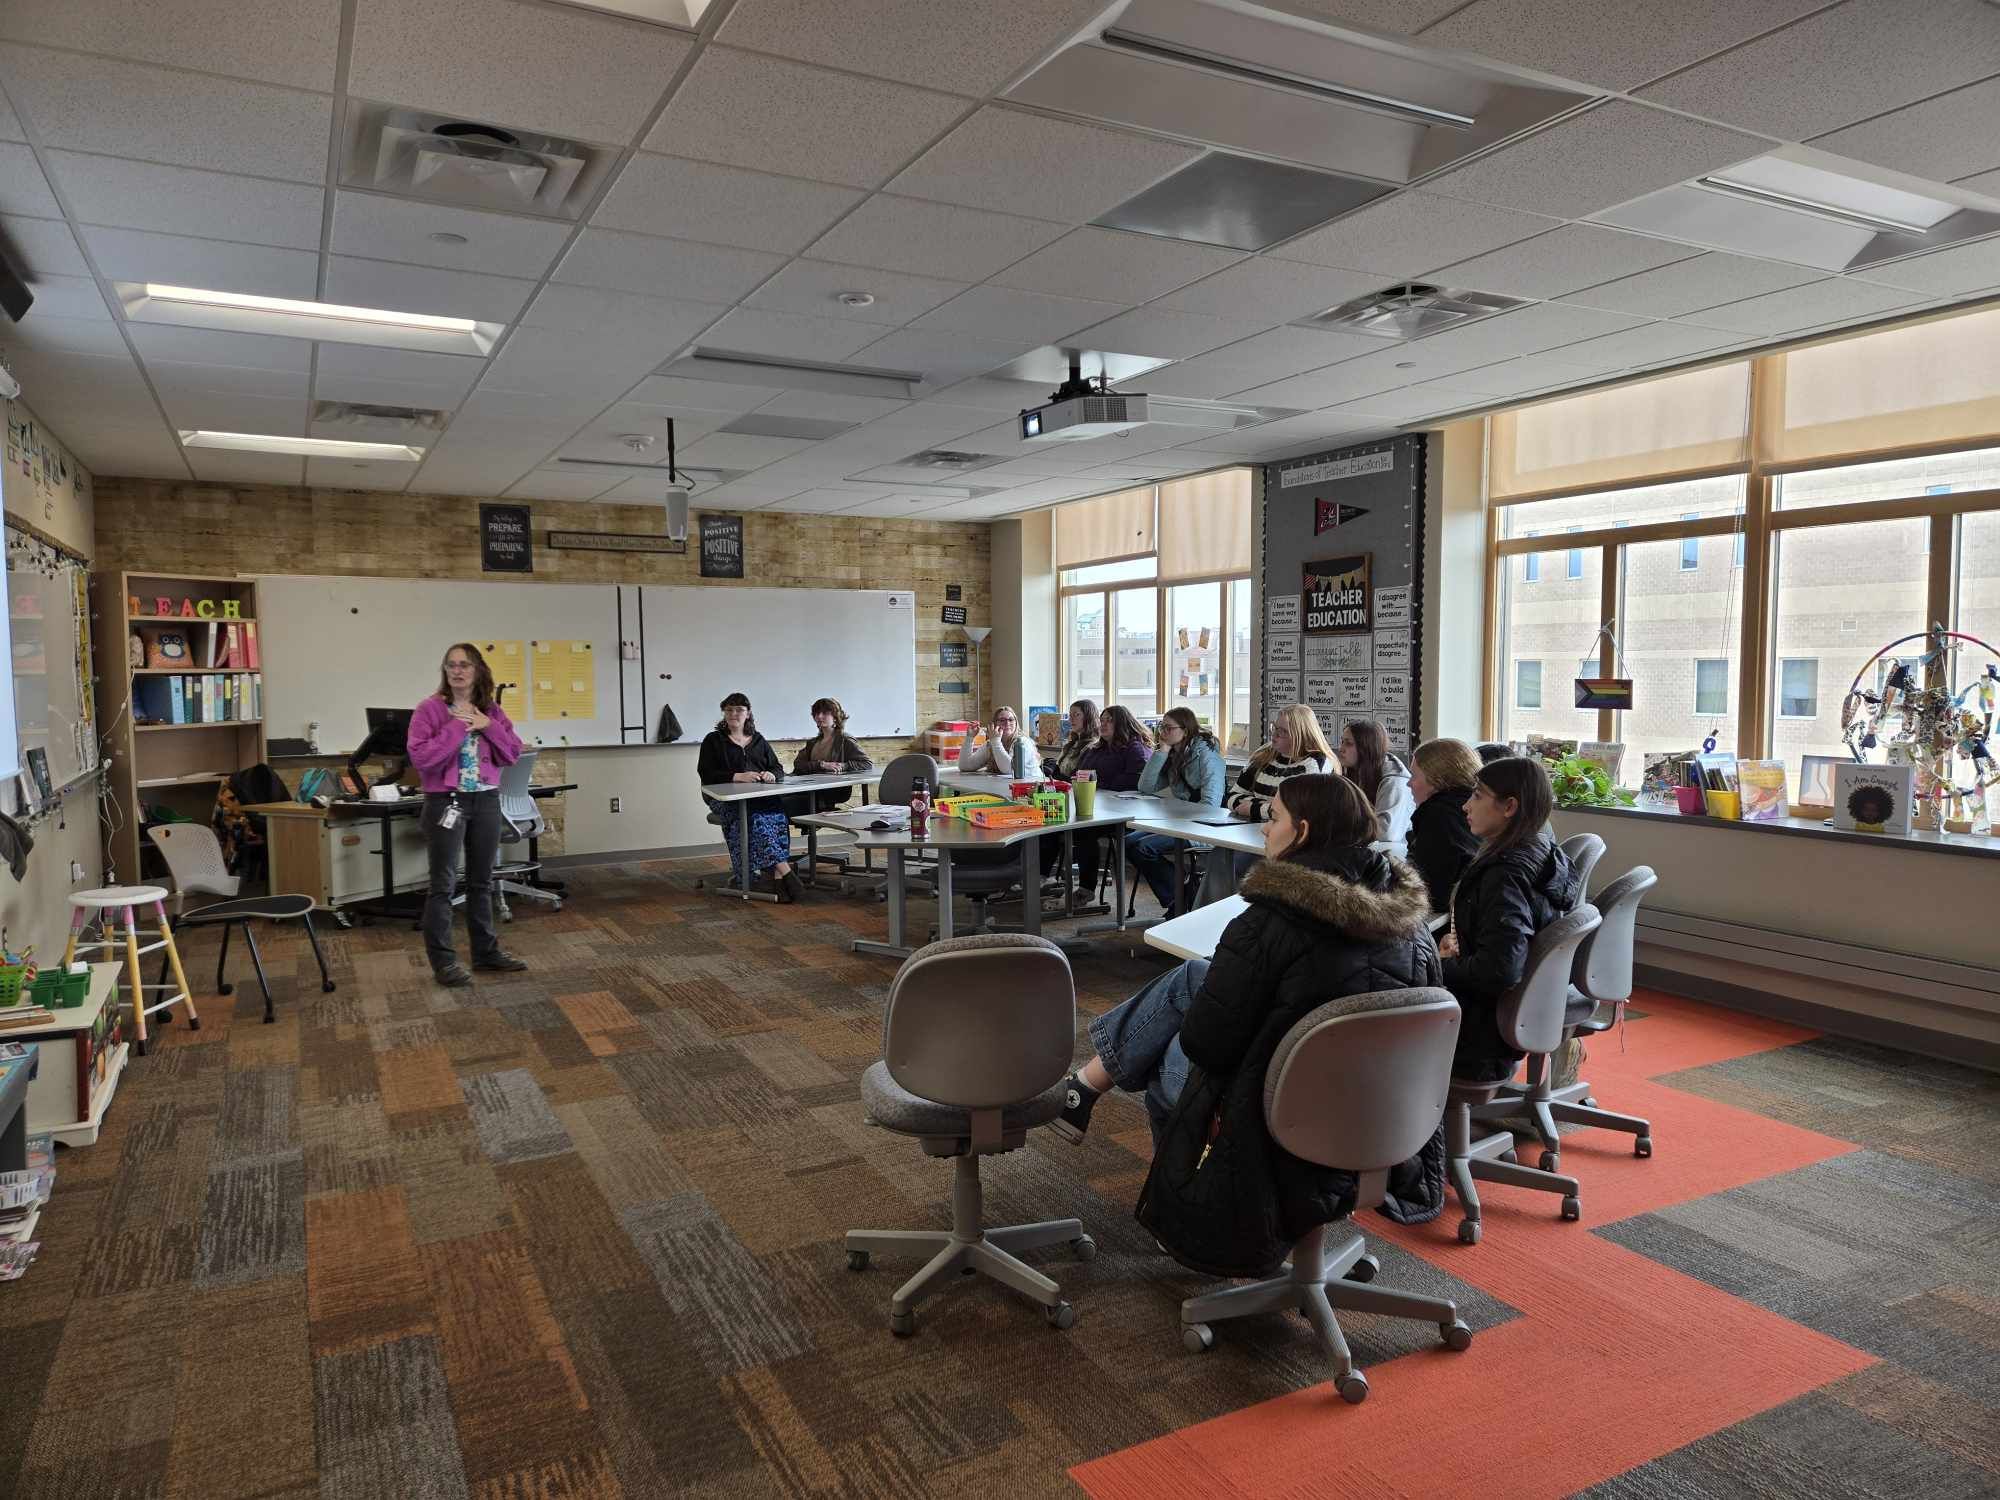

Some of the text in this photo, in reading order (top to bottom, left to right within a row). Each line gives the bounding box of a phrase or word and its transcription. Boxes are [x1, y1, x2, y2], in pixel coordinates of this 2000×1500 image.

[488, 523, 523, 533] PREPARE
[704, 526, 737, 536] POSITIVE
[490, 542, 524, 552] PREPARING
[704, 538, 740, 557] POSITIVE
[1312, 589, 1363, 607] TEACHER
[1382, 593, 1407, 602] disagree
[128, 596, 240, 618] TEACH
[1307, 609, 1367, 628] EDUCATION
[1376, 642, 1408, 650] respectfully
[1386, 727, 1405, 735] nfused
